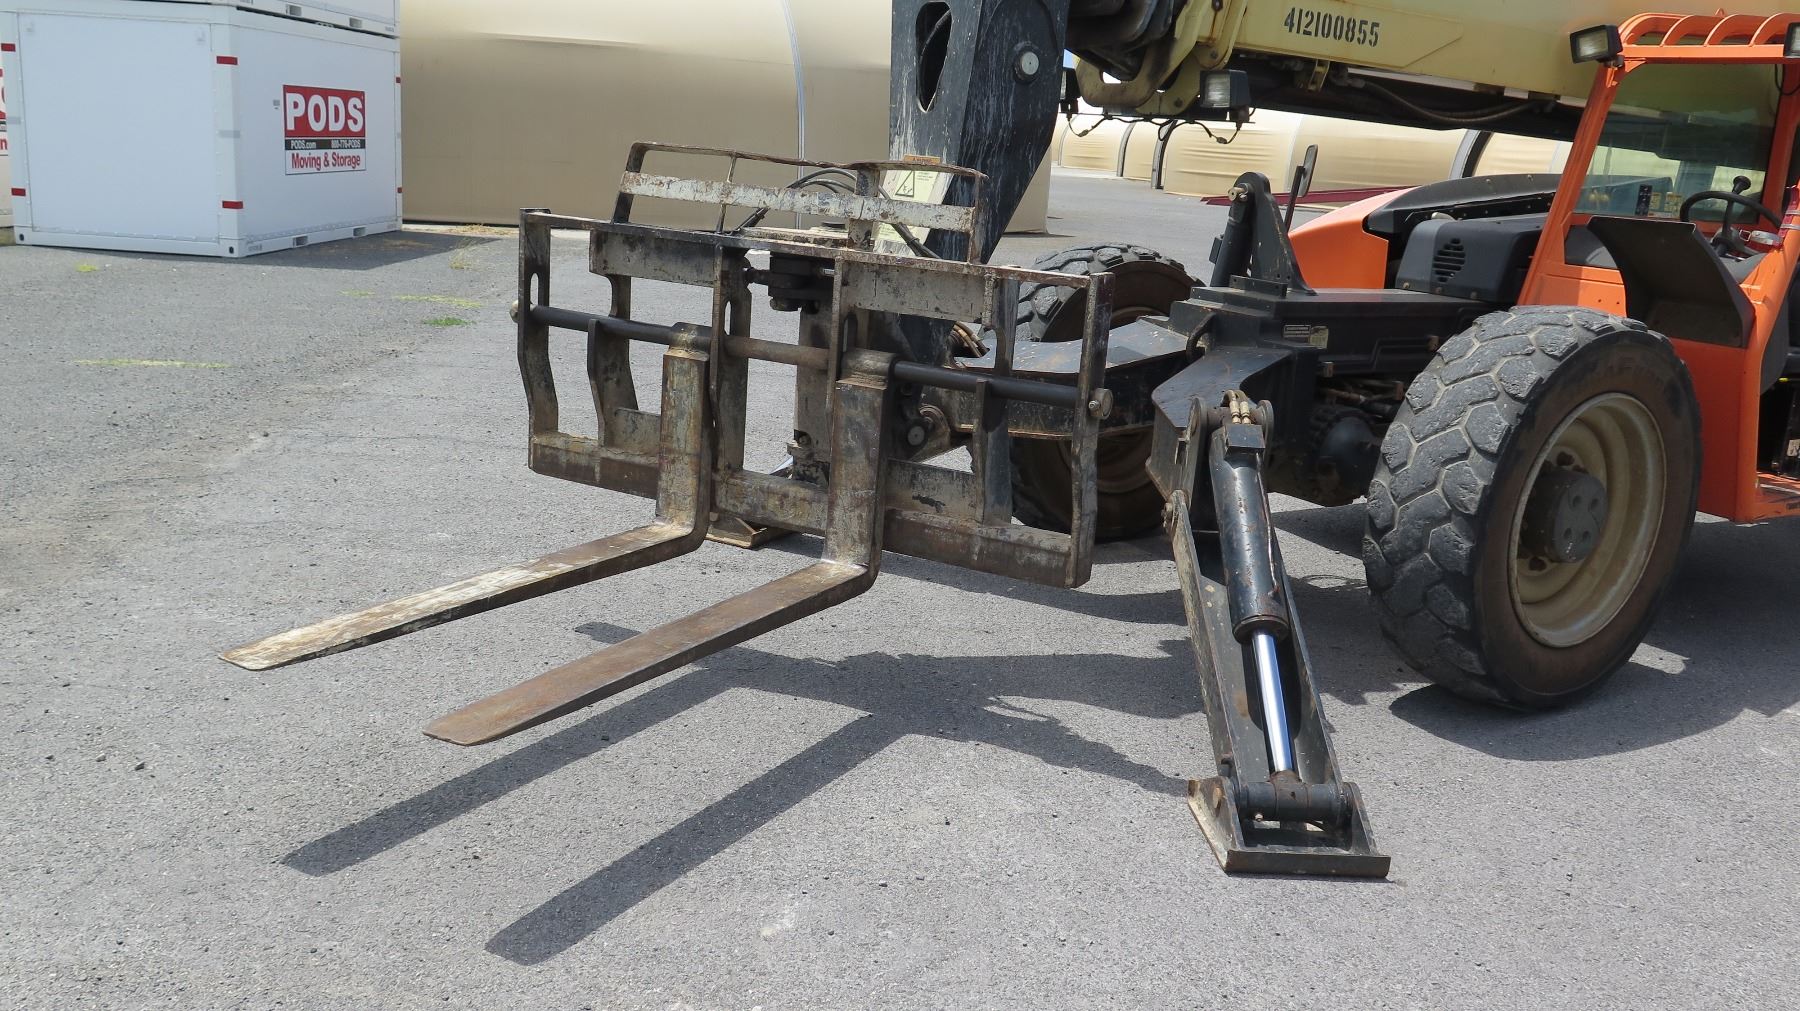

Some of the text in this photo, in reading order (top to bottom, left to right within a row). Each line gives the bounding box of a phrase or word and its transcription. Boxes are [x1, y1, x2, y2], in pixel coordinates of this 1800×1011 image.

[1284, 7, 1380, 47] 412100855
[286, 93, 363, 132] PODS
[291, 140, 317, 149] PODS.com
[292, 151, 361, 171] Moving & Storage
